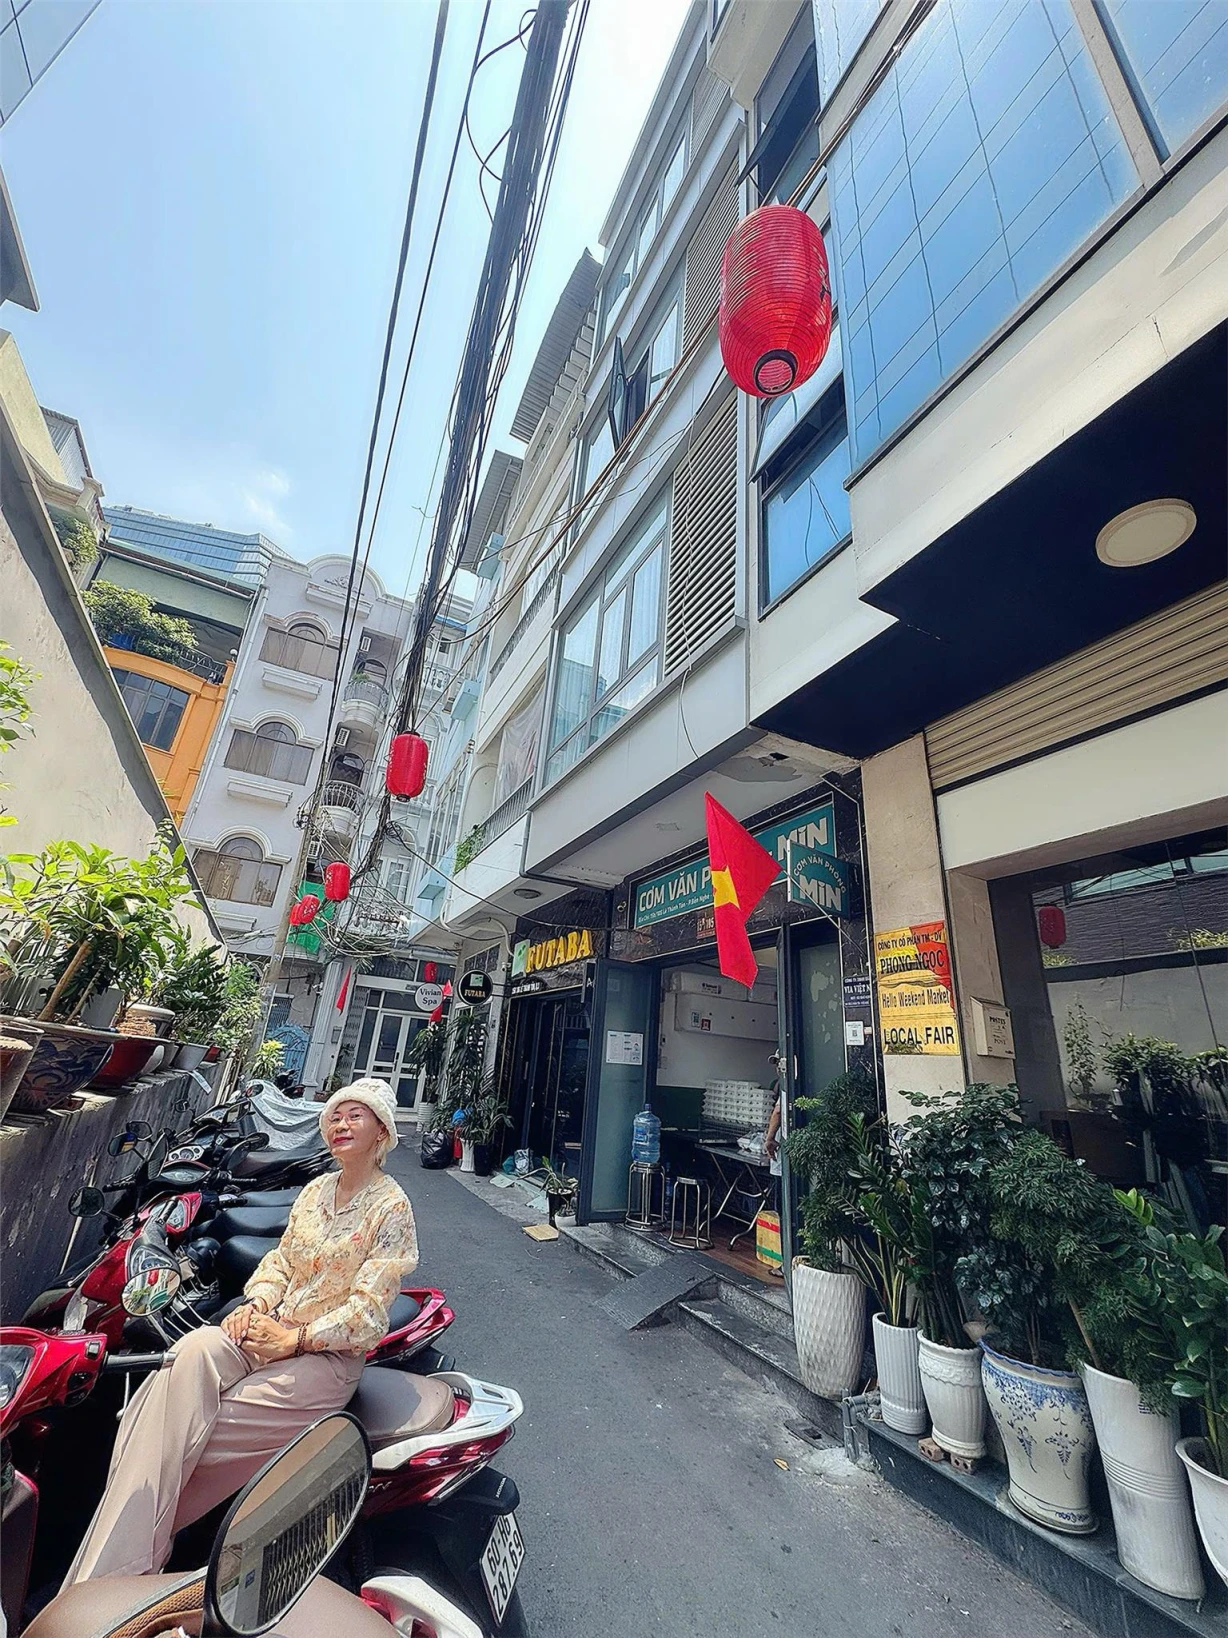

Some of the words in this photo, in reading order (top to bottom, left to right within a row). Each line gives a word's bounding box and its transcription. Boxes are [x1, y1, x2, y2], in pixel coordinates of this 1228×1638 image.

[668, 871, 697, 901] VĂN
[525, 929, 591, 973] FUTABA
[880, 954, 913, 975] PHONG
[914, 950, 945, 972] NGỌC
[420, 988, 442, 997] Vivian
[422, 997, 438, 1006] Spa
[464, 989, 486, 998] FUTABA
[897, 989, 926, 1008] Weekend
[926, 987, 950, 1005] Market
[883, 1027, 923, 1045] LOCAL
[924, 1026, 955, 1046] FAIR
[493, 1530, 522, 1614] 287.69
